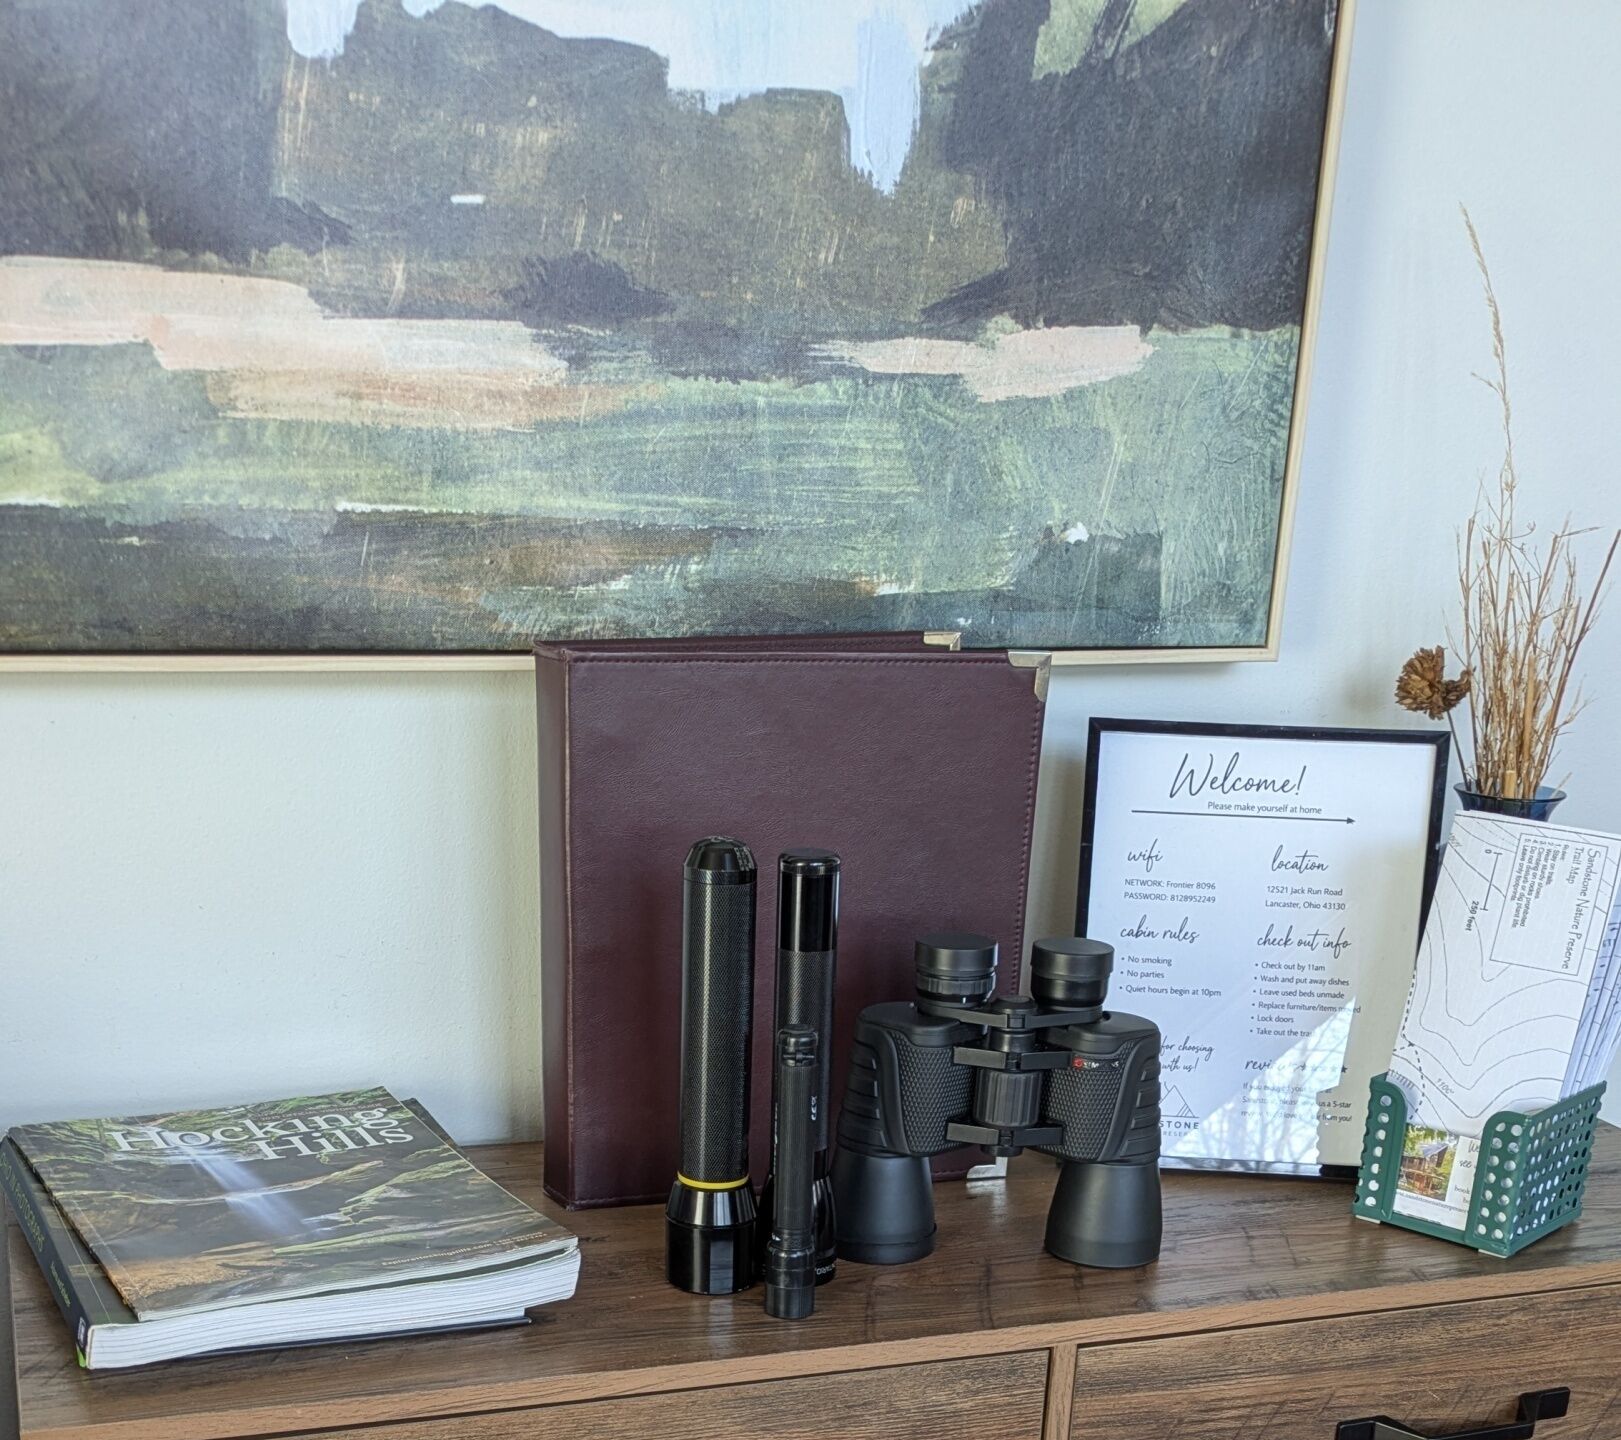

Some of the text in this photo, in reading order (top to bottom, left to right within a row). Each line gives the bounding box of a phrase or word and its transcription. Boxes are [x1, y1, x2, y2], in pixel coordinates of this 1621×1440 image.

[1169, 752, 1307, 799] Welcome!
[1207, 801, 1232, 810] Please
[1234, 803, 1256, 811] make
[1257, 804, 1288, 813] yourself
[1299, 806, 1322, 814] home
[1127, 838, 1164, 872] wifi
[1529, 845, 1538, 855] Do
[1271, 843, 1329, 874] location
[1566, 847, 1585, 885] Trail Map
[1124, 878, 1216, 890] NETWORK: Frontier 8096
[1267, 885, 1343, 896] 12521 Jack Run Road
[1123, 892, 1216, 903] PASSWORD: 8128952249
[1265, 900, 1346, 910] Lancaster, Ohio 43130
[1561, 848, 1601, 970] Sandstone Nature Preserve
[1465, 900, 1480, 932] 250 feet
[1120, 914, 1200, 944] cabin rules
[1257, 923, 1352, 959] check out info
[1127, 955, 1172, 967] No smoking
[1261, 961, 1282, 970] Check
[1297, 963, 1306, 972] by
[1126, 969, 1165, 979] No parties
[1260, 975, 1279, 983] Wash
[1295, 977, 1307, 985] put
[1309, 979, 1327, 987] away
[1328, 978, 1350, 986] dishes
[1125, 984, 1146, 993] Quiet
[1147, 986, 1168, 994] hours
[1170, 986, 1190, 997] begin
[1201, 988, 1222, 997] 10pm
[1259, 988, 1345, 999] Leave used beds unmade
[1258, 1001, 1285, 1011] Replace
[1286, 1002, 1337, 1012] furniture/items
[1257, 1014, 1294, 1023] Lock doors
[1256, 1027, 1272, 1036] Take
[1287, 1028, 1299, 1037] the
[1160, 1035, 1215, 1062] for choosing
[1162, 1055, 1200, 1072] with us!
[1332, 1100, 1352, 1108] 5-star
[1160, 1120, 1200, 1129] STONE
[1338, 1115, 1353, 1123] you!
[105, 1106, 400, 1152] Hocking
[247, 1124, 414, 1161] Hills
